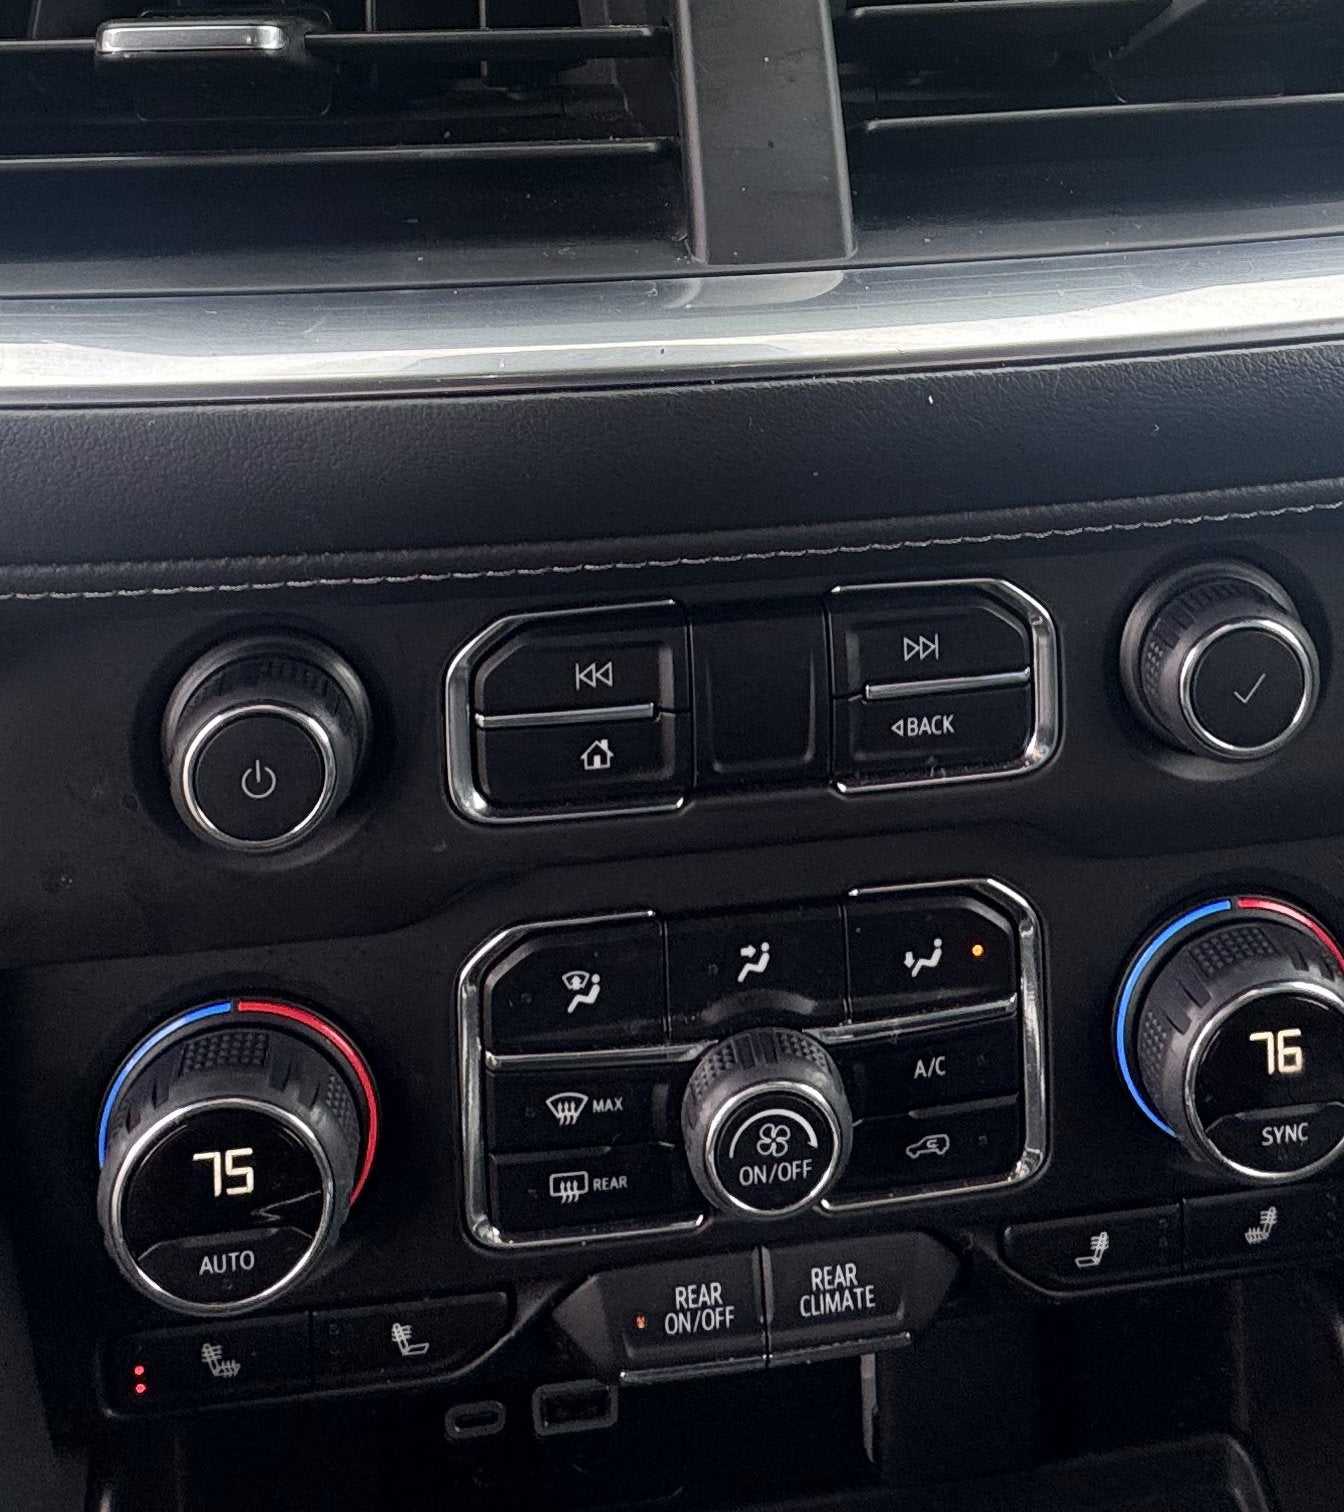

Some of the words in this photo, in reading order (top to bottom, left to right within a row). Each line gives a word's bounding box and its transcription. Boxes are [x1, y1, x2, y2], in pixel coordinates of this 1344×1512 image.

[907, 714, 955, 736] BACK
[1249, 1028, 1303, 1075] 76
[913, 1056, 946, 1078] A/C
[592, 1097, 623, 1113] MAX
[1261, 1122, 1309, 1146] SYNC
[192, 1147, 254, 1197] 75
[593, 1176, 628, 1192] REAR
[738, 1159, 813, 1186] ON/OFF
[199, 1250, 256, 1276] AUTO
[811, 1262, 858, 1291] REAR
[674, 1283, 723, 1308] REAR
[799, 1285, 876, 1318] CLIMATE
[664, 1307, 735, 1335] ON/OFF
